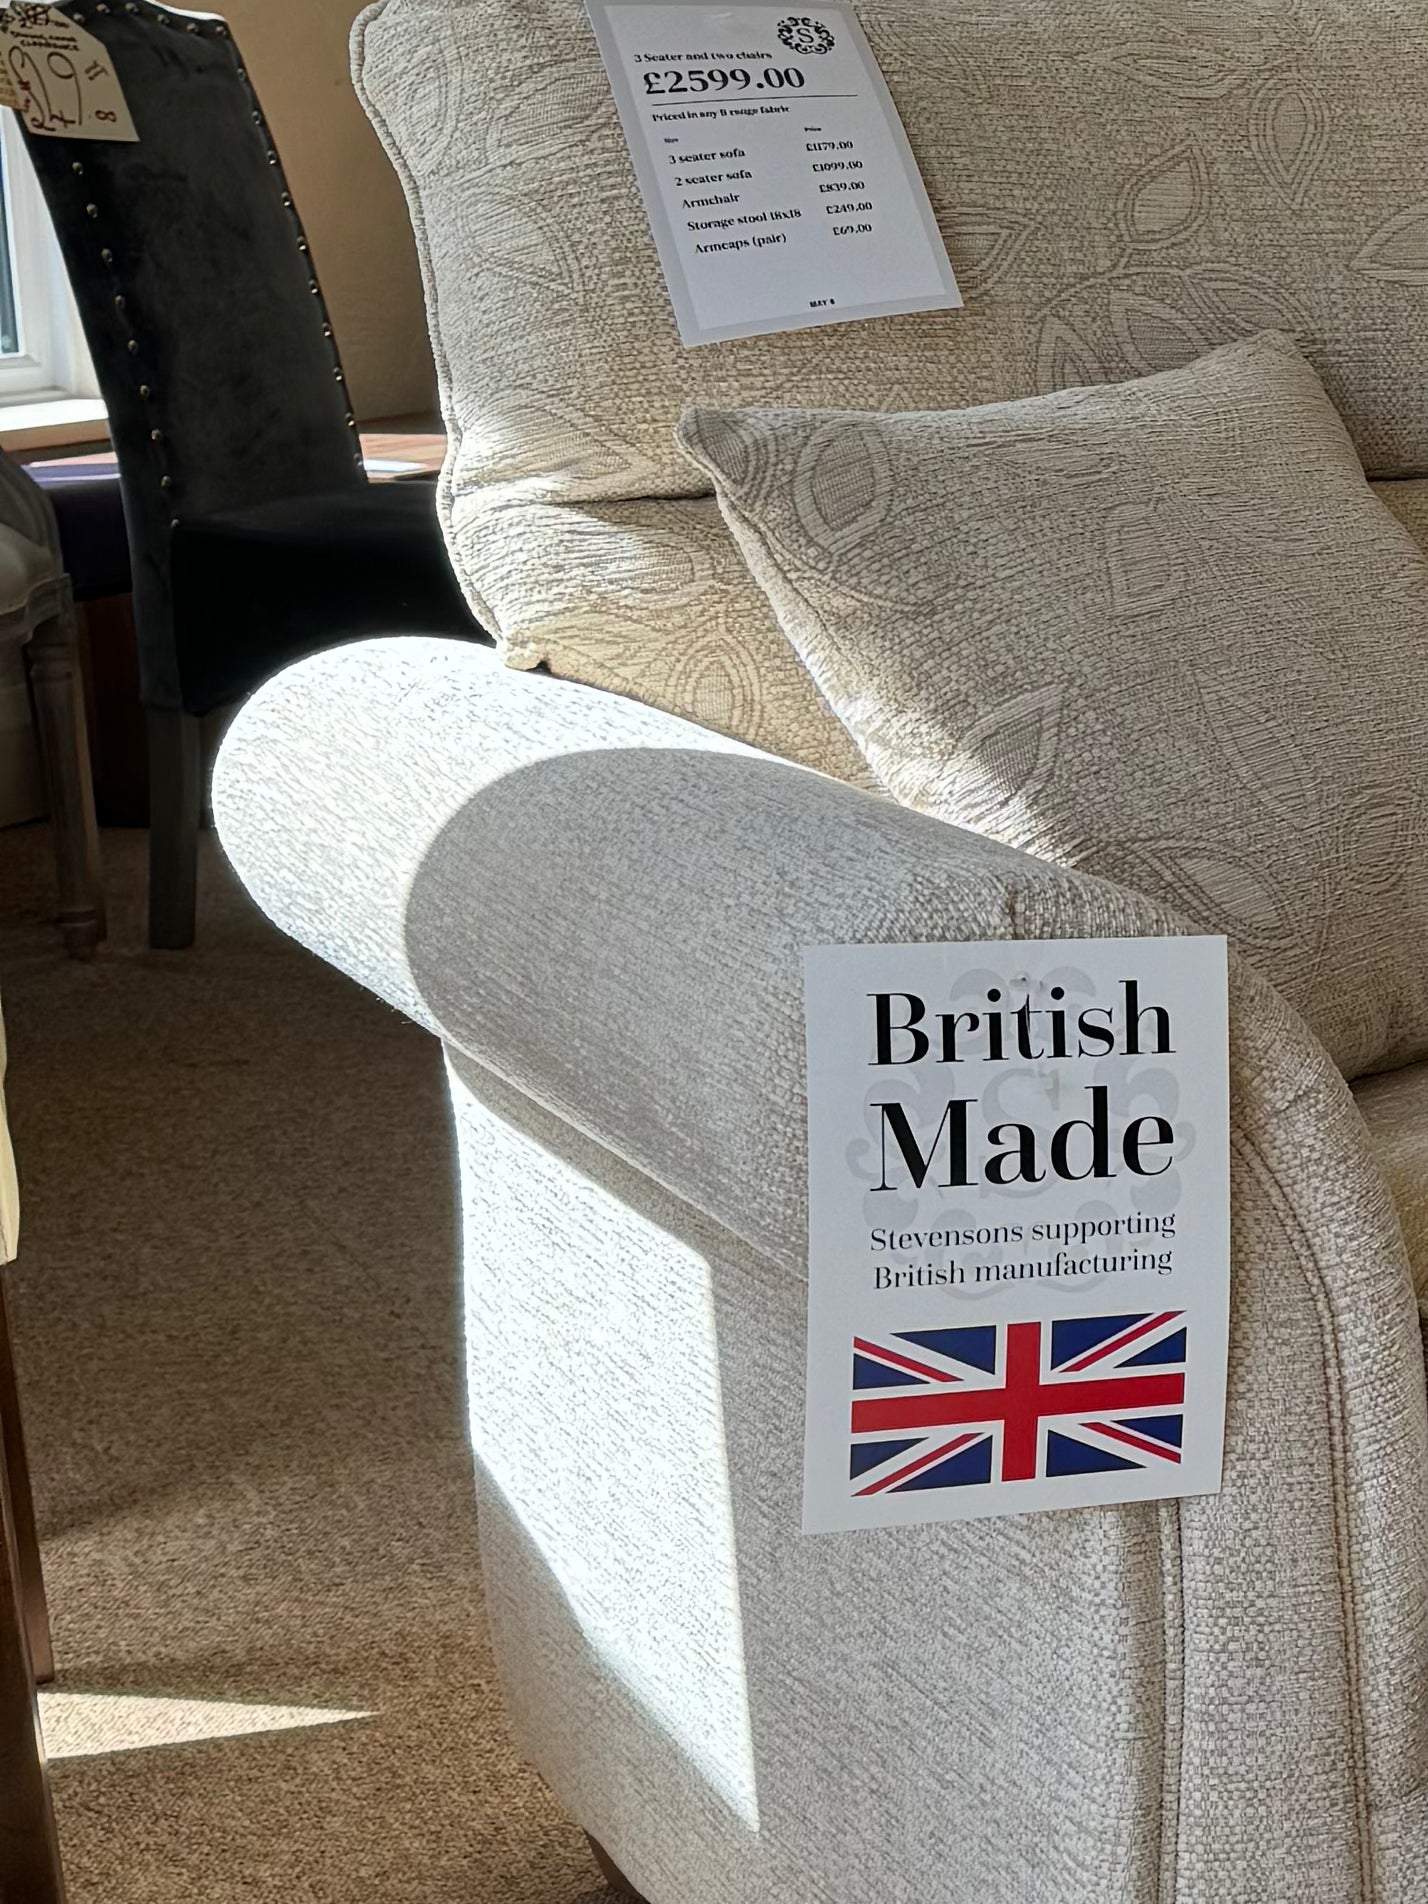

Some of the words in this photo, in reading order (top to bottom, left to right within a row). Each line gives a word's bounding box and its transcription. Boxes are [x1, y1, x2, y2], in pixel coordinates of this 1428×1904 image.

[634, 54, 642, 62] 3
[643, 53, 683, 62] Seater
[686, 52, 708, 60] and
[711, 52, 734, 60] two
[736, 51, 773, 60] chairs
[643, 67, 805, 95] £2599.00
[652, 111, 686, 122] Priced
[687, 110, 698, 119] in
[760, 106, 790, 114] fabric
[669, 155, 676, 165] 3
[679, 151, 716, 163] seater
[720, 148, 746, 159] sofa
[675, 177, 683, 187] 2
[685, 173, 723, 185] seater
[726, 170, 753, 180] sofa
[682, 193, 741, 209] Armchair
[826, 202, 873, 215] £249.00
[687, 219, 735, 233] Storage
[737, 212, 767, 225] stool
[832, 223, 873, 236] £69.00
[695, 238, 750, 254] Armcaps
[752, 233, 787, 247] (pair)
[866, 979, 1177, 1067] British
[869, 1085, 1175, 1192] Made
[870, 1223, 1023, 1251] Stevensons
[1031, 1211, 1176, 1245] supporting
[874, 1260, 965, 1290] British
[975, 1248, 1173, 1283] manufacturing
